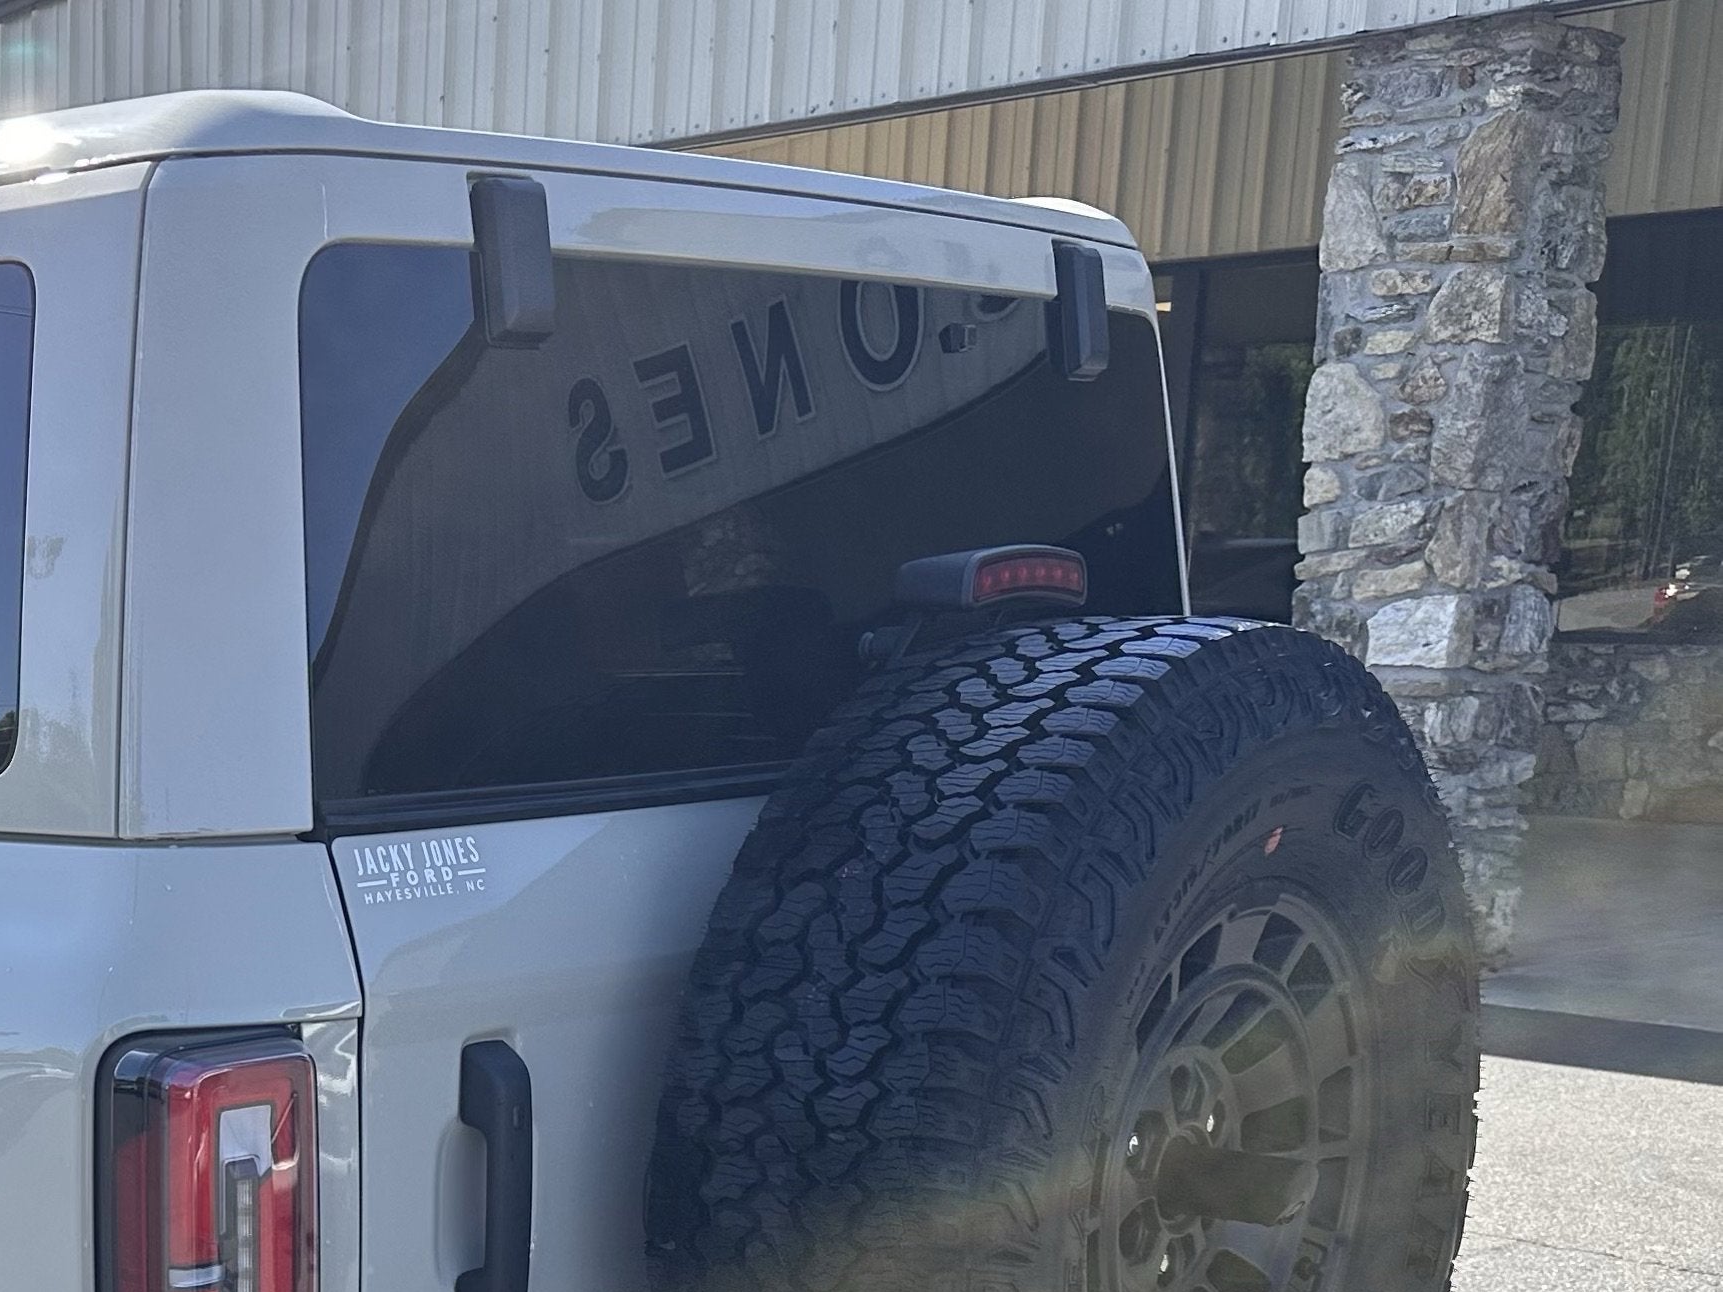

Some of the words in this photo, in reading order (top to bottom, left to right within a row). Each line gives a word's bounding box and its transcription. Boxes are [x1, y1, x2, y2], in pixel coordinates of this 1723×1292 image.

[353, 842, 414, 876] JACKY
[421, 836, 480, 869] JONES
[390, 866, 453, 888] FORD
[364, 882, 460, 905] HAYESVILLE,
[465, 878, 486, 892] NC
